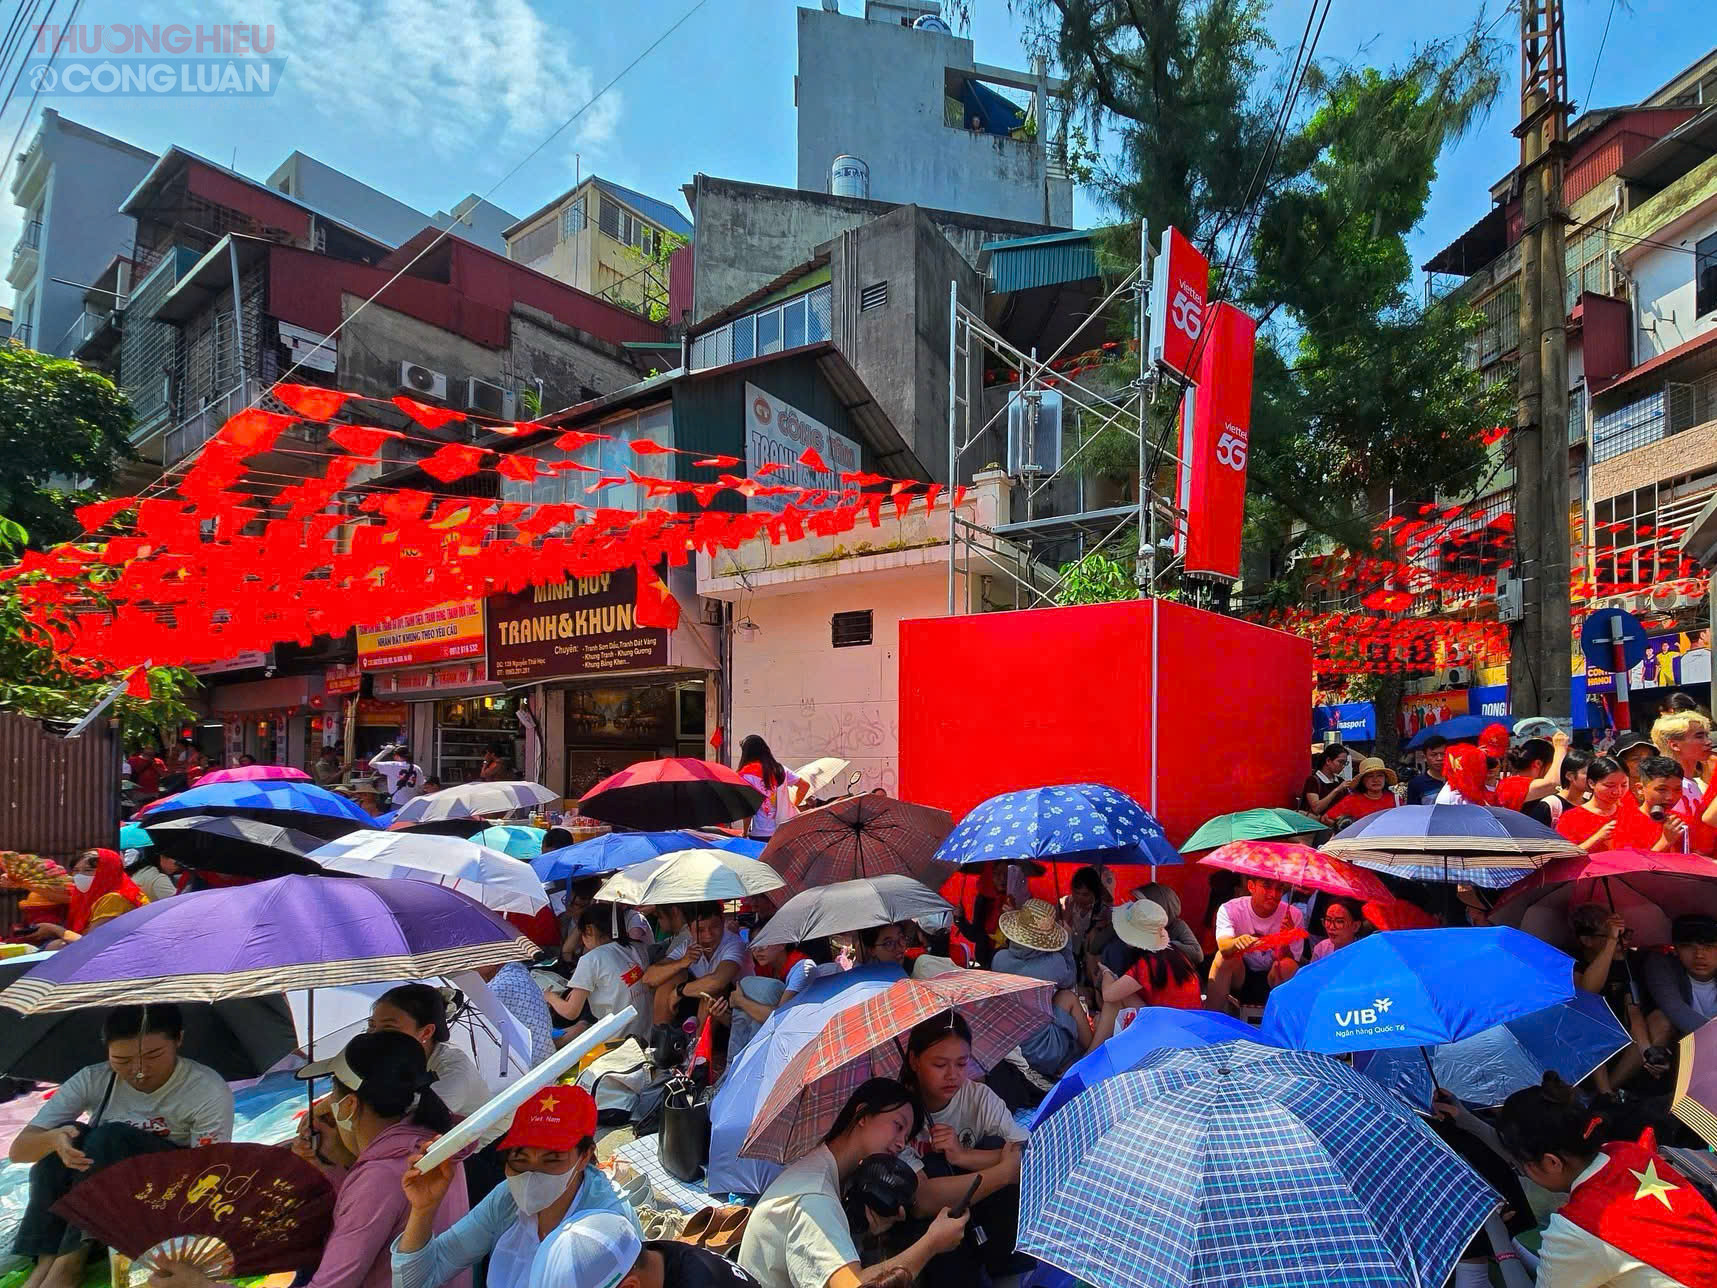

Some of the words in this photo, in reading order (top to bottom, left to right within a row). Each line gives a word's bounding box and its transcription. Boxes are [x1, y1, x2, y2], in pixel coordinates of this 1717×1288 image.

[1179, 278, 1202, 306] viettel
[1172, 291, 1202, 340] 5G
[1224, 421, 1248, 441] viettel
[1216, 432, 1247, 471] 5G
[421, 629, 435, 640] THEO
[1335, 1008, 1378, 1027] VIB
[1335, 1029, 1355, 1038] Ngân
[1355, 1027, 1373, 1036] hàng
[1374, 1024, 1394, 1034] Quốc
[1395, 1023, 1405, 1031] Tế
